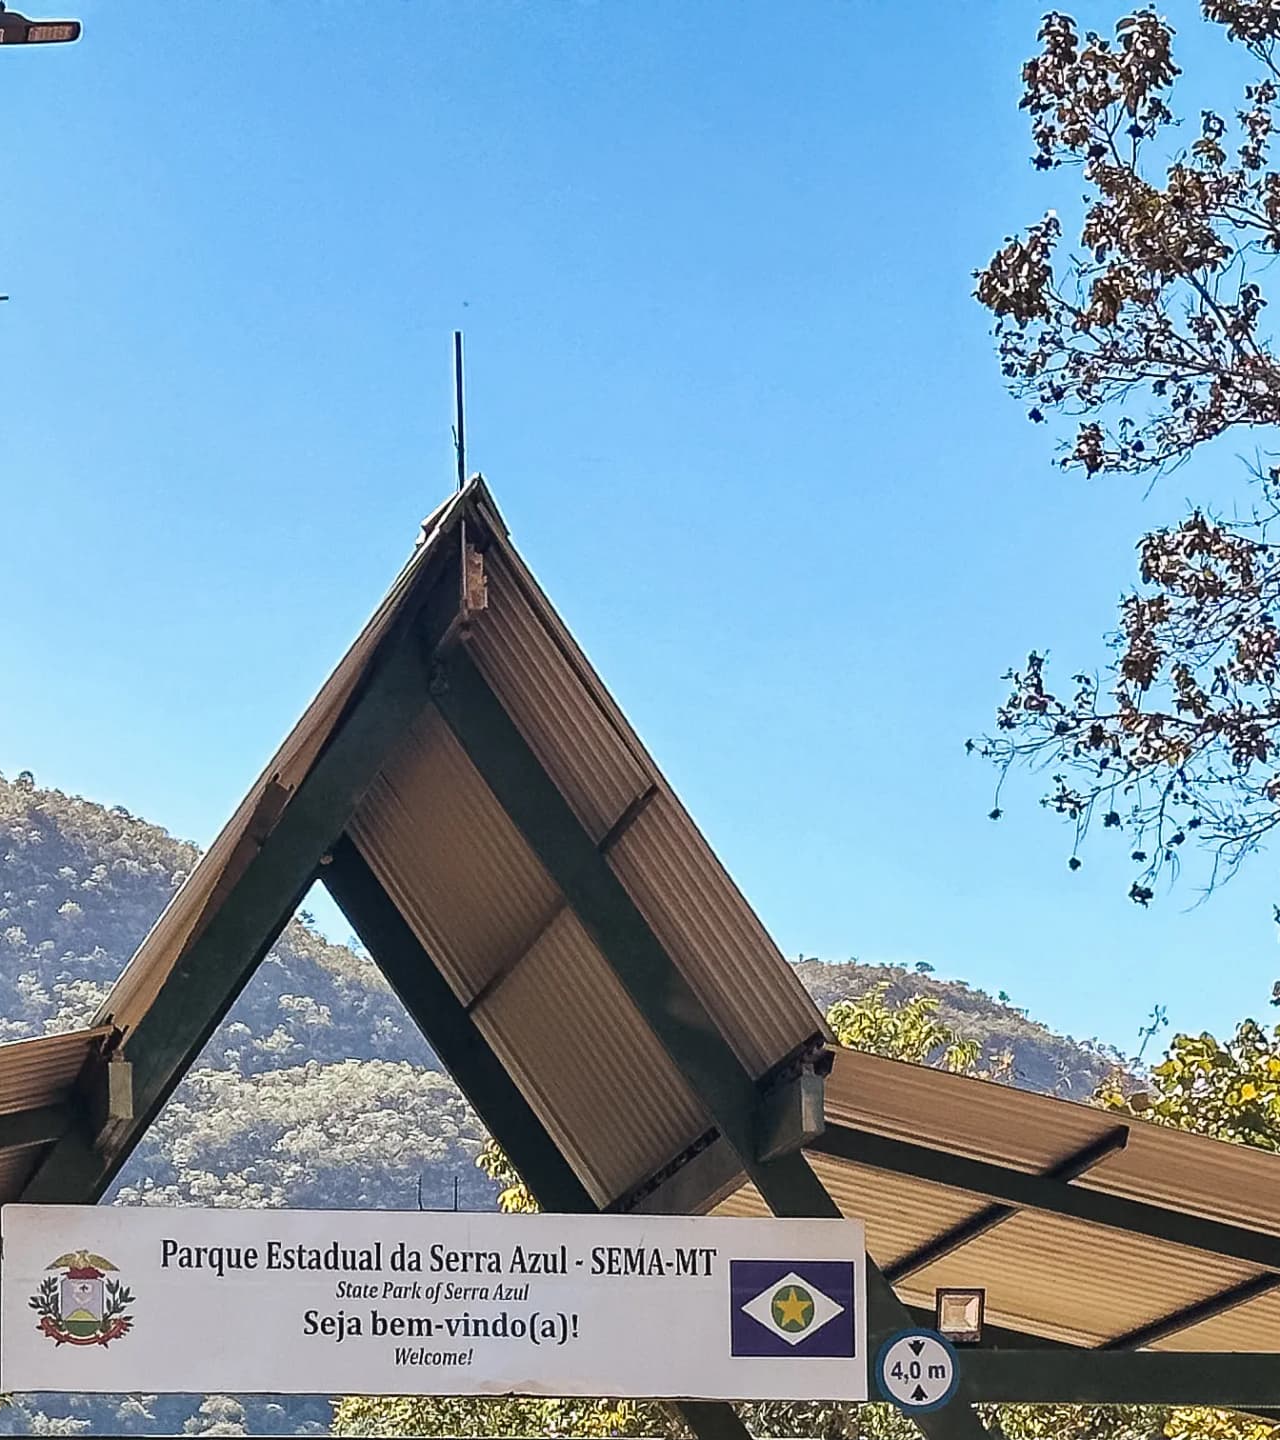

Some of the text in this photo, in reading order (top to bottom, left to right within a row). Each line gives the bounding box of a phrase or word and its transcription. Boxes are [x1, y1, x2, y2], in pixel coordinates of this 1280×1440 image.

[160, 1239, 259, 1277] Parque
[266, 1241, 382, 1271] Estadual
[390, 1243, 423, 1273] da
[430, 1244, 502, 1273] Serra
[509, 1245, 568, 1275] Azul
[591, 1247, 717, 1277] SEMA-MT
[335, 1280, 530, 1304] State Park of Serra Azul
[303, 1310, 579, 1345] Seja bem-vindo(a)!
[394, 1348, 474, 1366] Welcome!
[890, 1361, 946, 1384] 4,0 m
